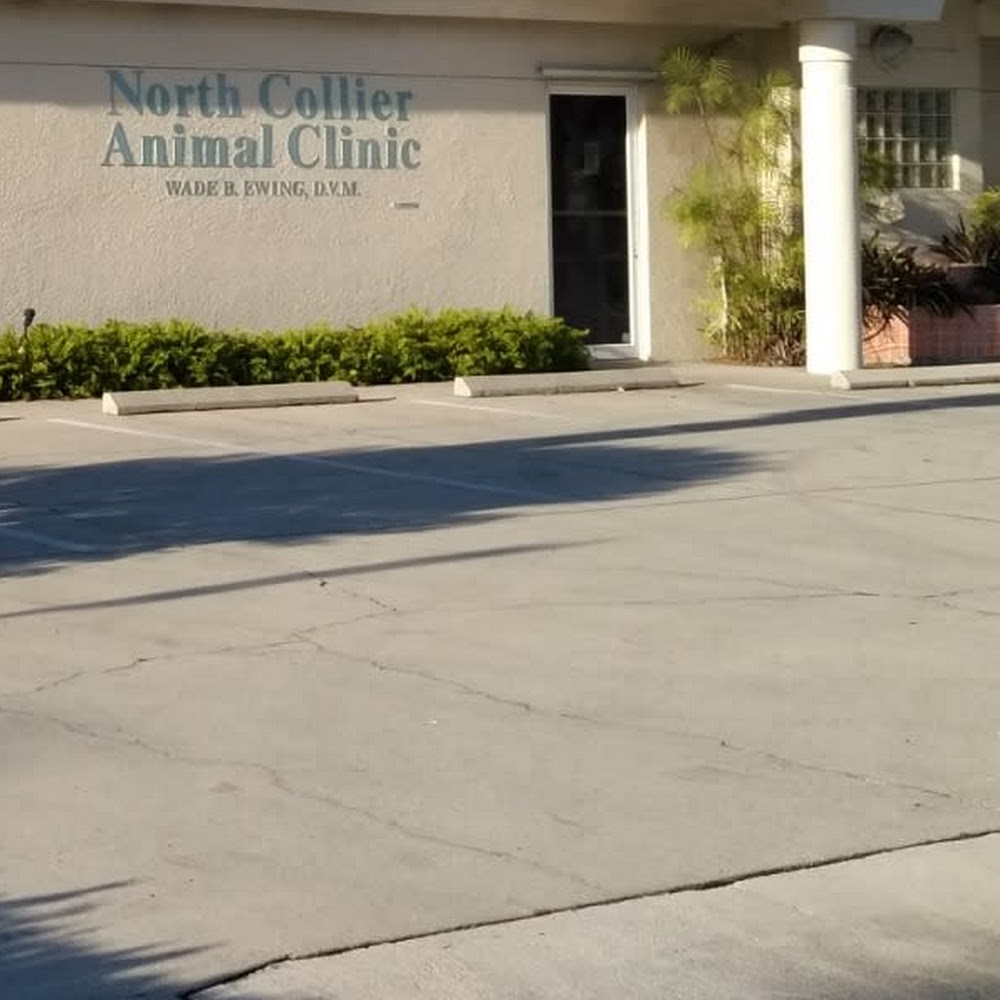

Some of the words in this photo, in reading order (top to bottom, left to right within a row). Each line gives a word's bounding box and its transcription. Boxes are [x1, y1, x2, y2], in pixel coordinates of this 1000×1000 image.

[104, 69, 243, 119] North
[257, 73, 414, 121] Collier
[100, 121, 276, 169] Animal
[287, 123, 422, 170] Clinic
[165, 180, 219, 197] WADE
[223, 180, 239, 197] B.
[244, 180, 309, 199] EWING,
[313, 180, 362, 198] D.V.M.
